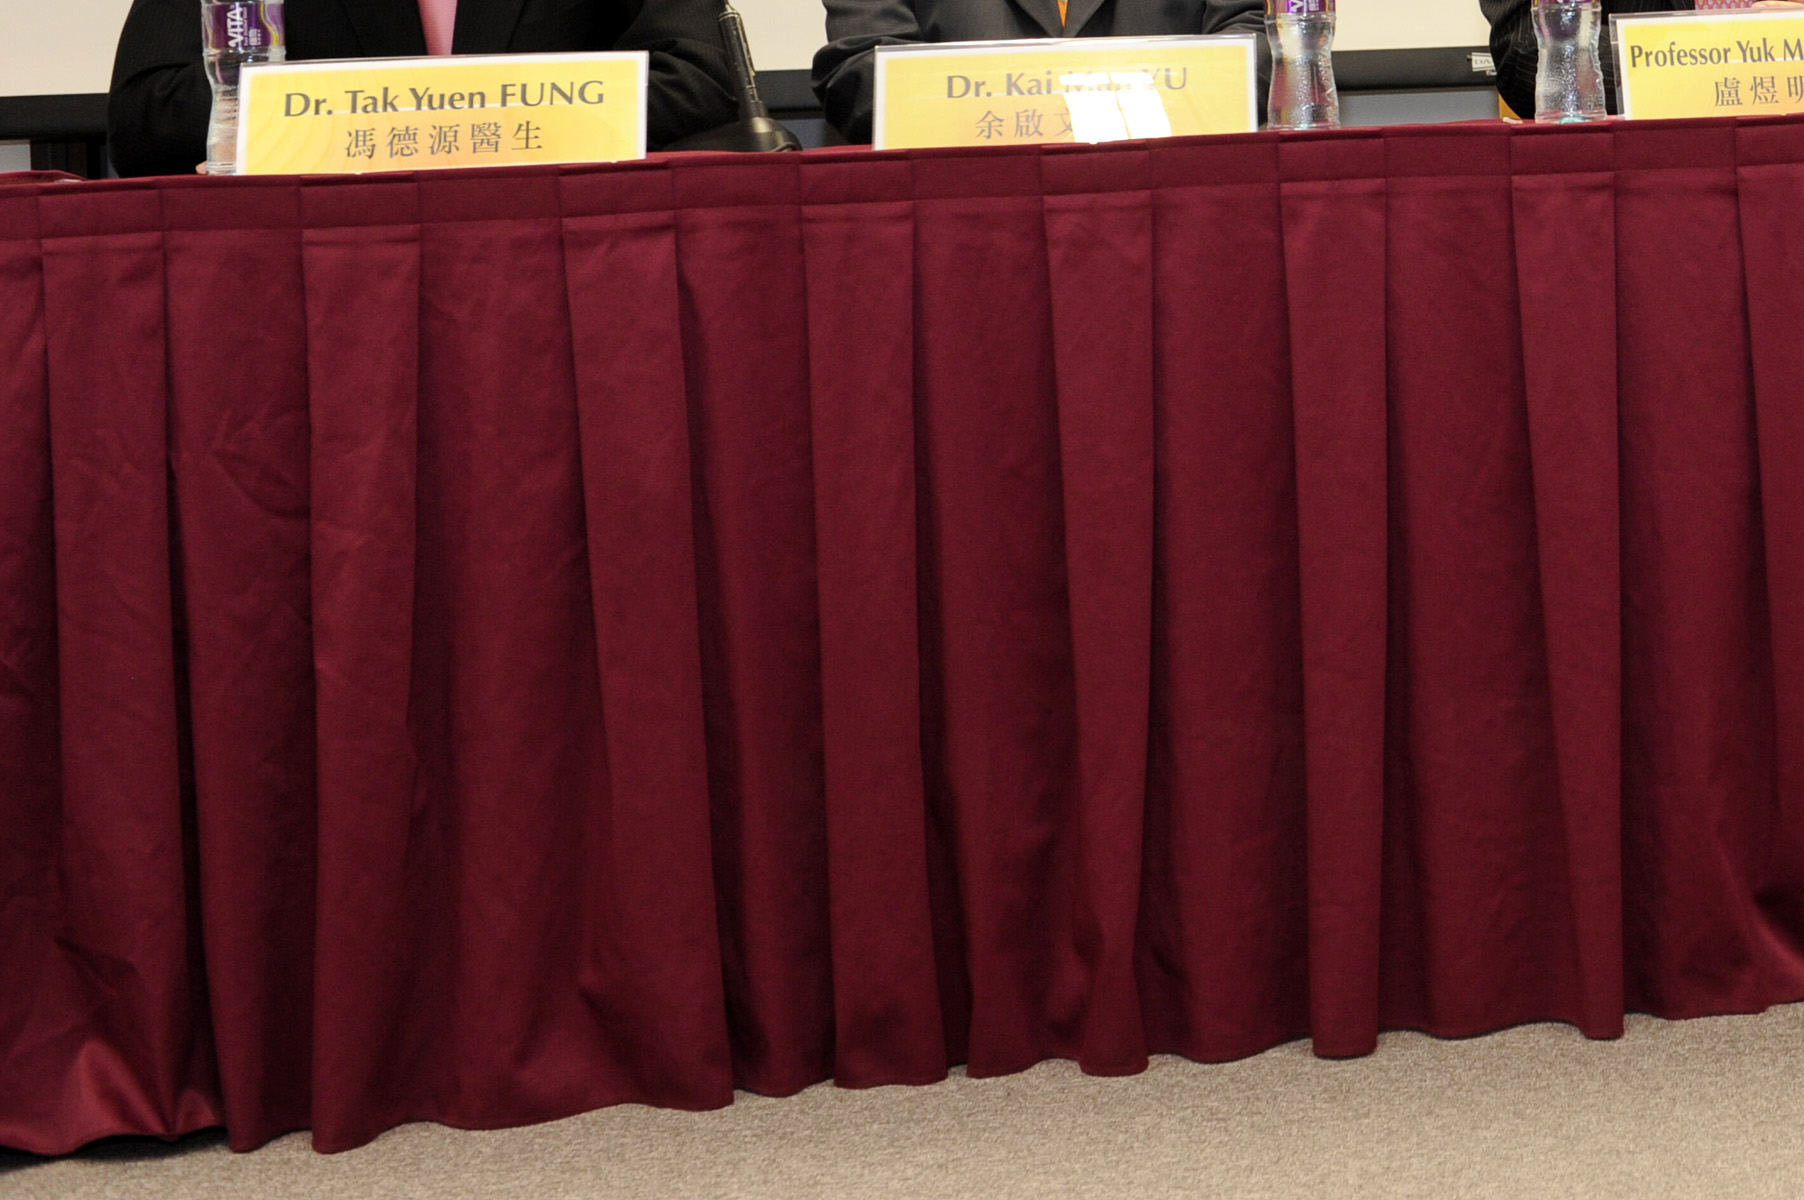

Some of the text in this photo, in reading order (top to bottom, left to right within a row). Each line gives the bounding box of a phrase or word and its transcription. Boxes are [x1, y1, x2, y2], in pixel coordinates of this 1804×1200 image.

[227, 6, 244, 47] VITA
[1630, 38, 1731, 69] Professor
[1736, 37, 1776, 64] Yuk
[284, 79, 605, 117] Dr. Tak Yuen FUNG
[947, 73, 993, 98] Dr.
[1006, 69, 1052, 95] Kai
[343, 120, 544, 160] 馮德源醫生
